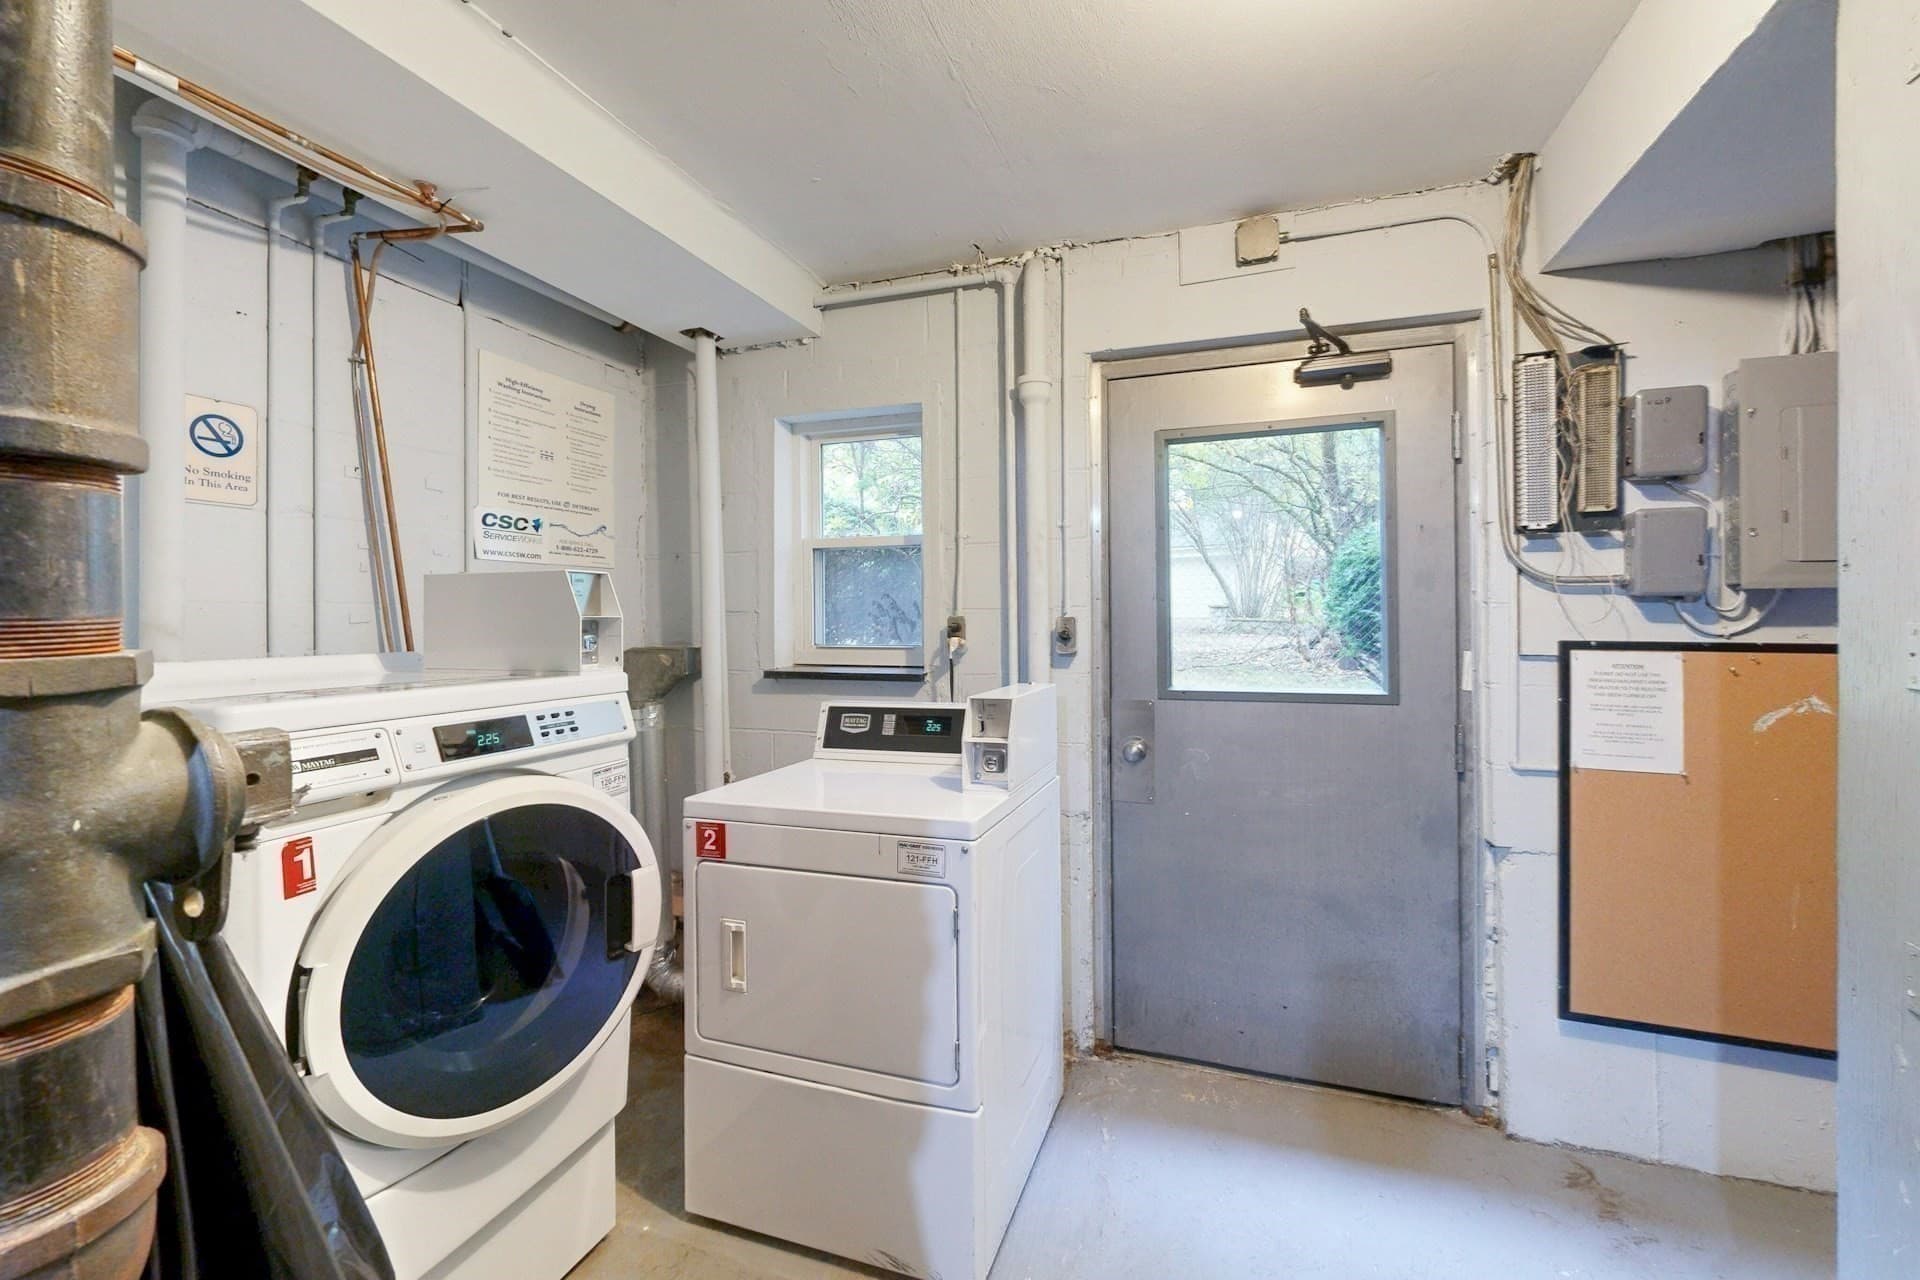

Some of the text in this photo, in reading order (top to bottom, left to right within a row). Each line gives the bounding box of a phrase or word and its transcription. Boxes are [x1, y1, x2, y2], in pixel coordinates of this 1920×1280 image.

[203, 467, 252, 483] Smoking
[198, 478, 222, 489] This
[224, 482, 249, 492] Area
[481, 512, 529, 531] CSC
[482, 548, 542, 560] www.cscsw.com
[301, 758, 336, 770] MAYTAG
[704, 829, 716, 850] 2
[293, 847, 312, 880] 1
